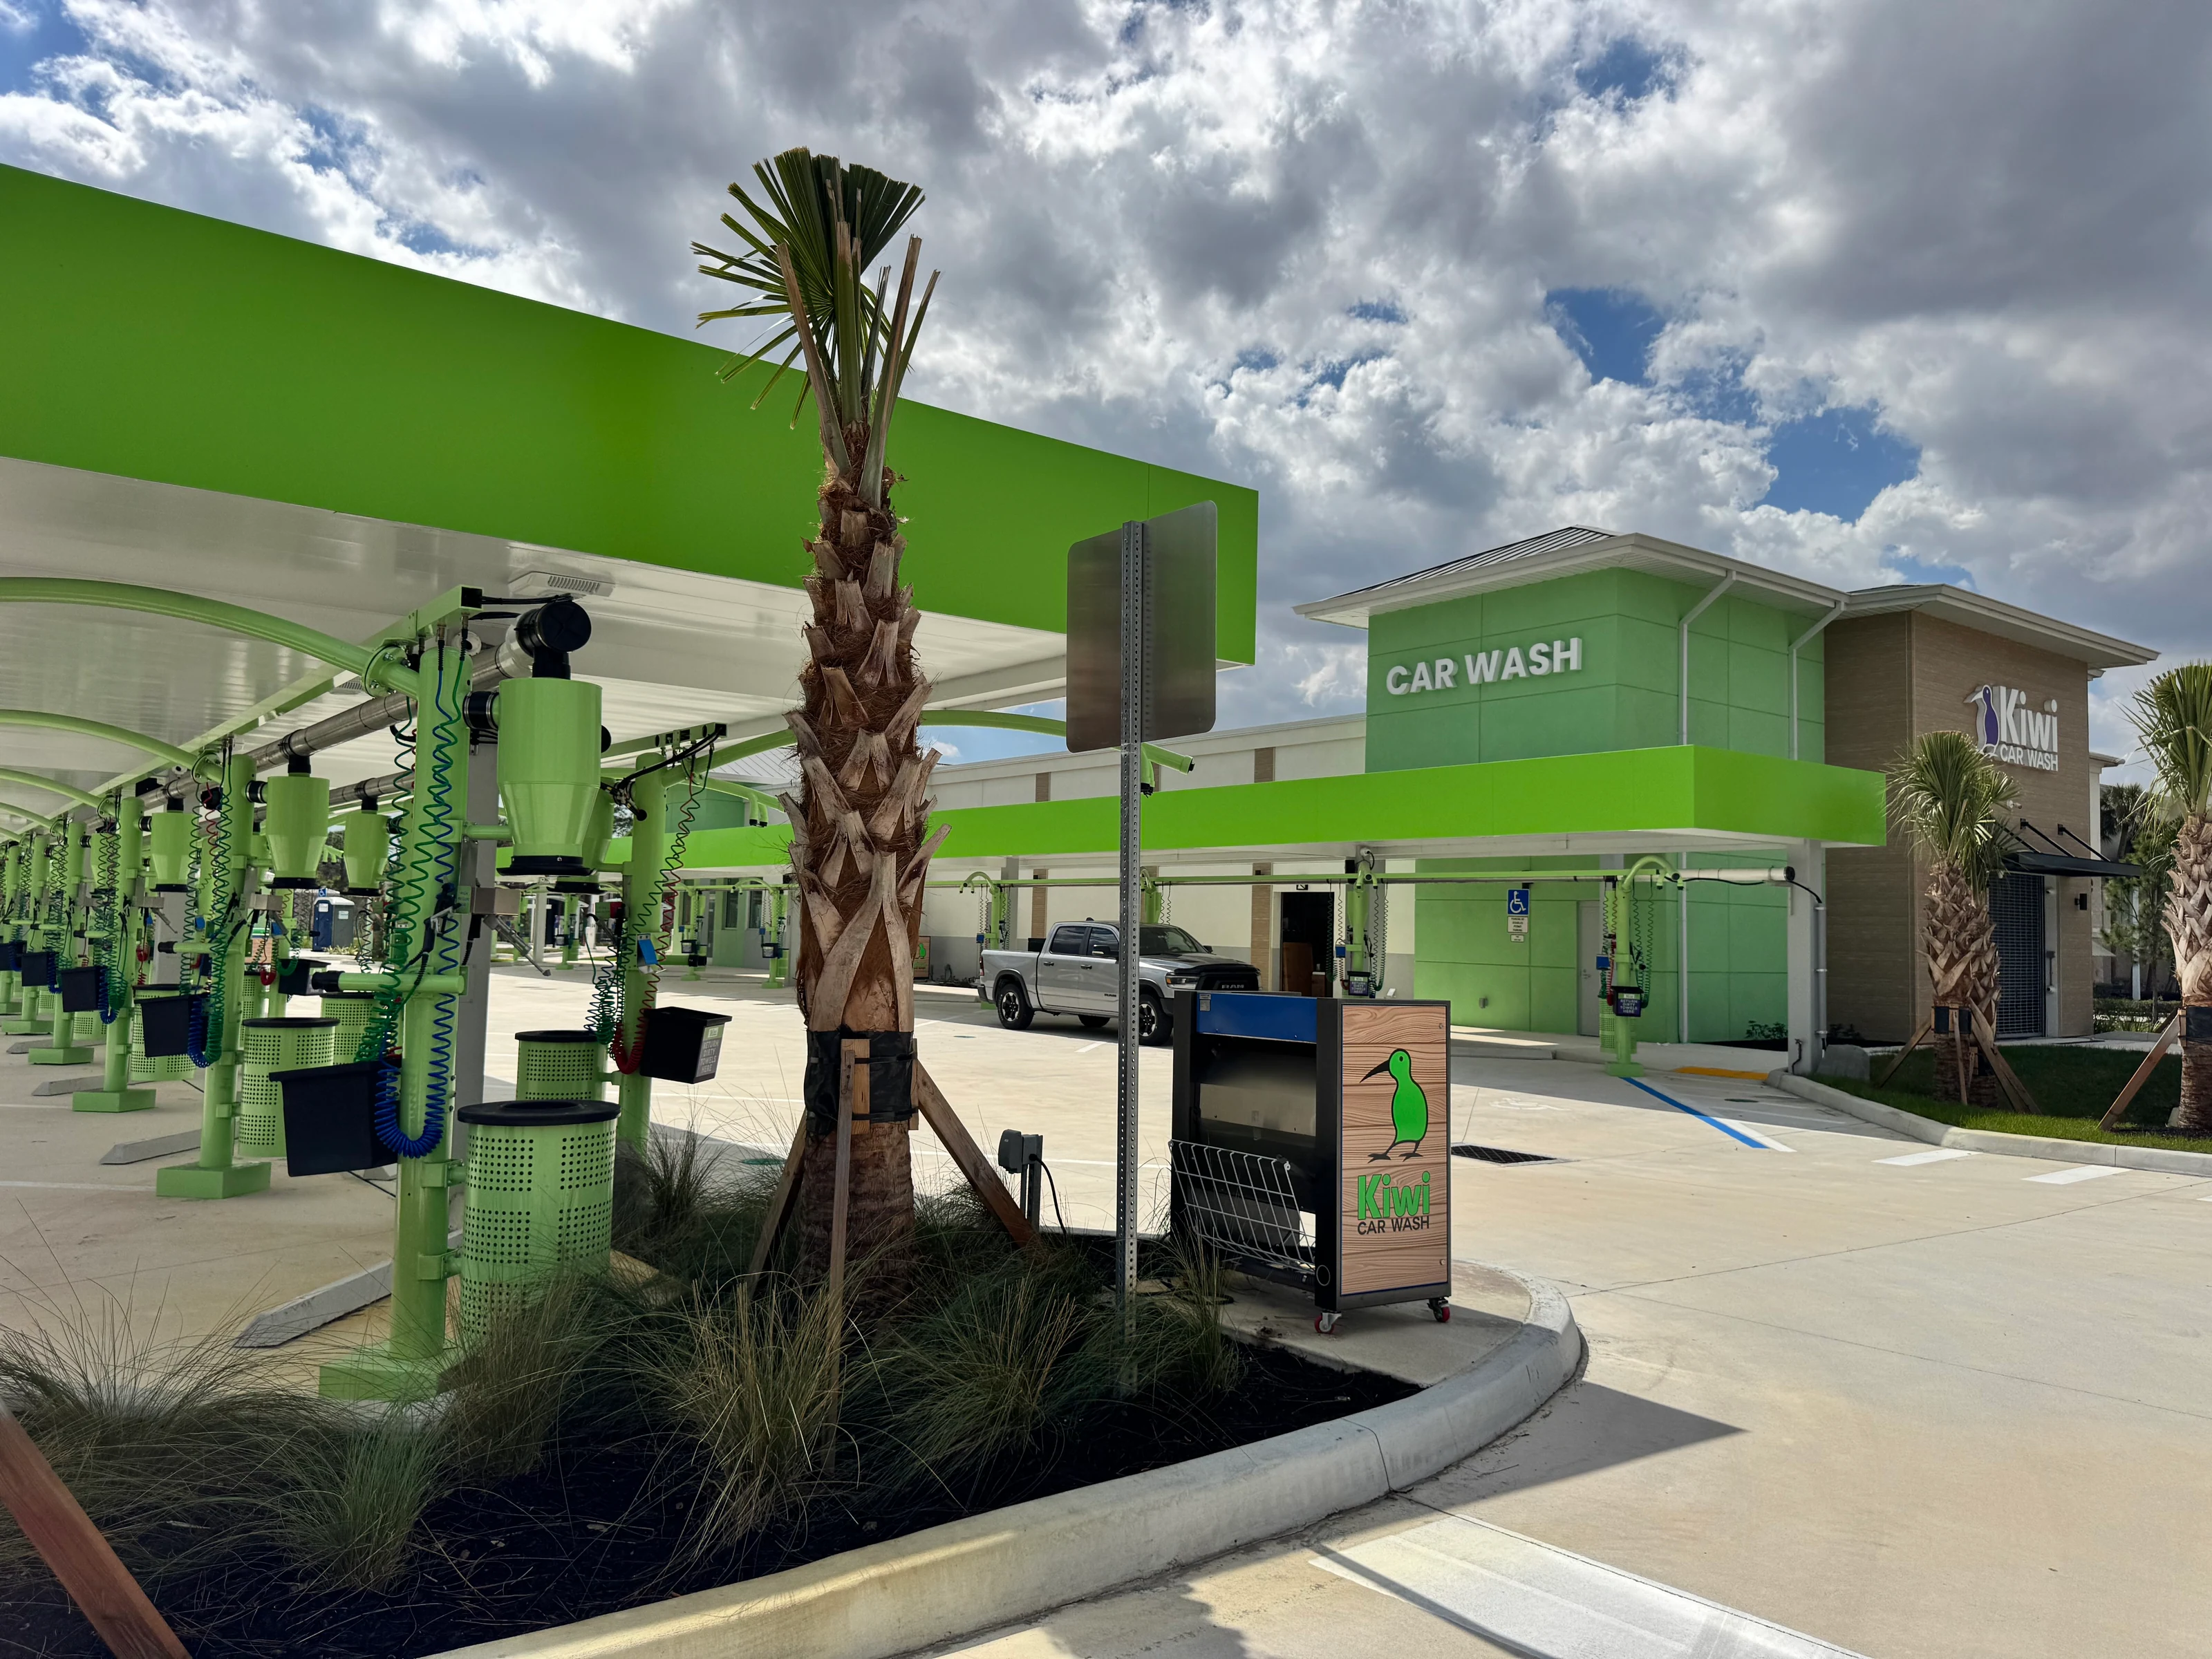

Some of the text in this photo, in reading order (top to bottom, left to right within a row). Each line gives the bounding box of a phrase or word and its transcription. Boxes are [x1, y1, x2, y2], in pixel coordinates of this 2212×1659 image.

[1386, 637, 1582, 695] CAR WASH
[1996, 686, 2059, 753] Kiwi
[1999, 743, 2059, 771] CAR WASH
[700, 1056, 717, 1065] TOWELS
[703, 1048, 716, 1057] DIRTY
[1357, 1170, 1431, 1221] Kiwi
[1357, 1215, 1430, 1235] CAR WASH
